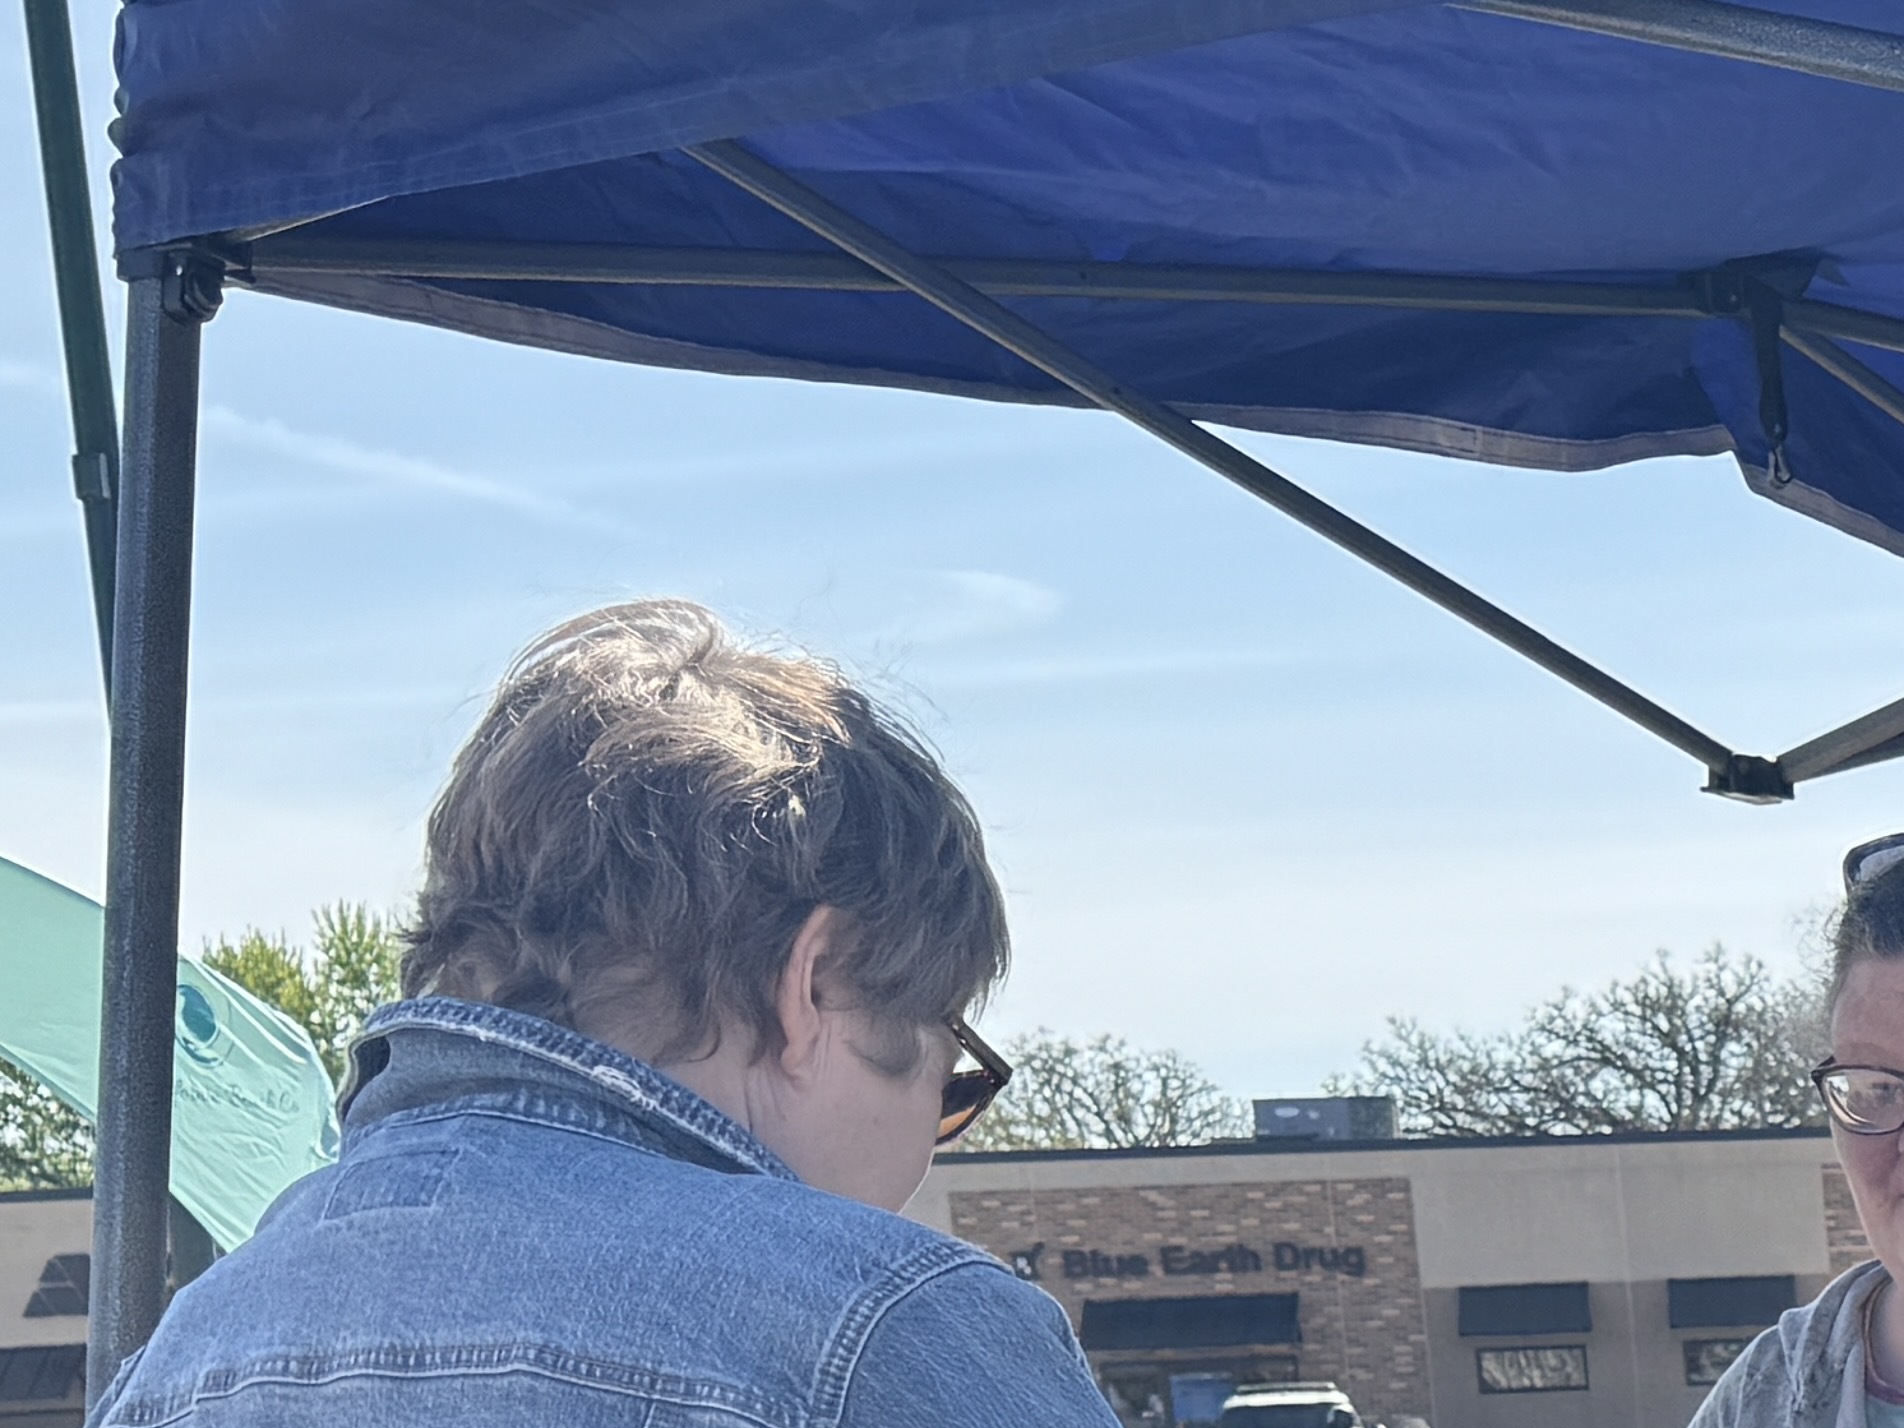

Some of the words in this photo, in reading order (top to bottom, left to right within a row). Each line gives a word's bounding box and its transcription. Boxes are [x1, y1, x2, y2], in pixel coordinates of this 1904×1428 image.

[1063, 1248, 1149, 1277] Blue
[1160, 1244, 1263, 1276] Earth
[1272, 1240, 1367, 1278] Drug
